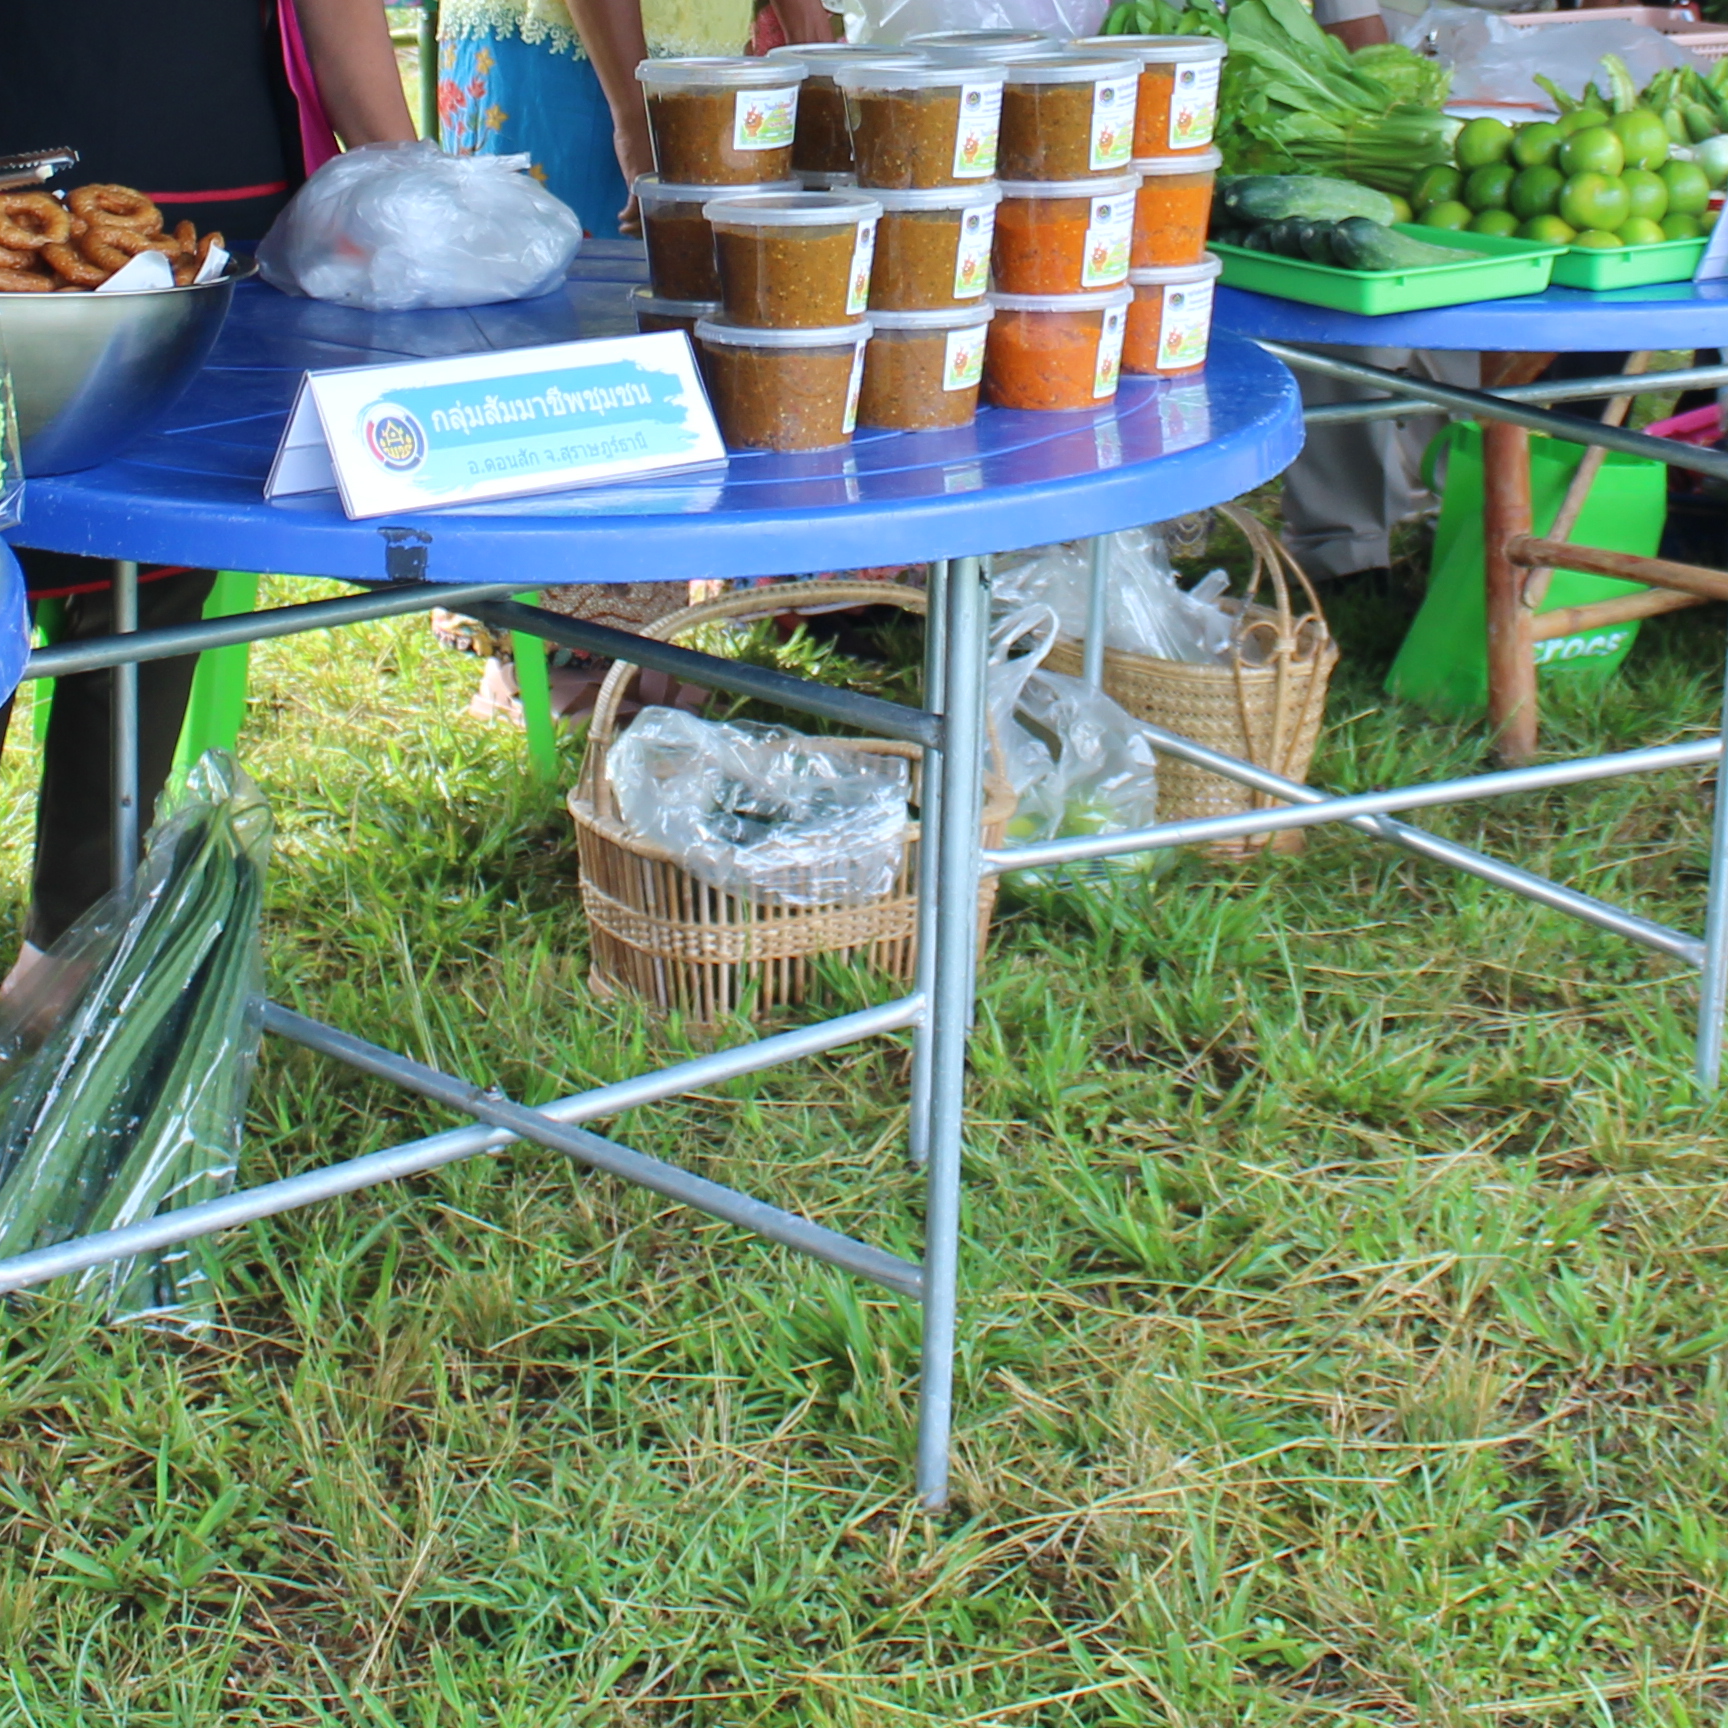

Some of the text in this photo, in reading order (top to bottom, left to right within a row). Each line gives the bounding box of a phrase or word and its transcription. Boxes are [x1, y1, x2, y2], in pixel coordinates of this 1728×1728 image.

[430, 381, 653, 436] กลุ่มสัมมาชีพชุมชน
[467, 430, 649, 475] อ.ดอนสัก จ.สุราษฎร์ธานี
